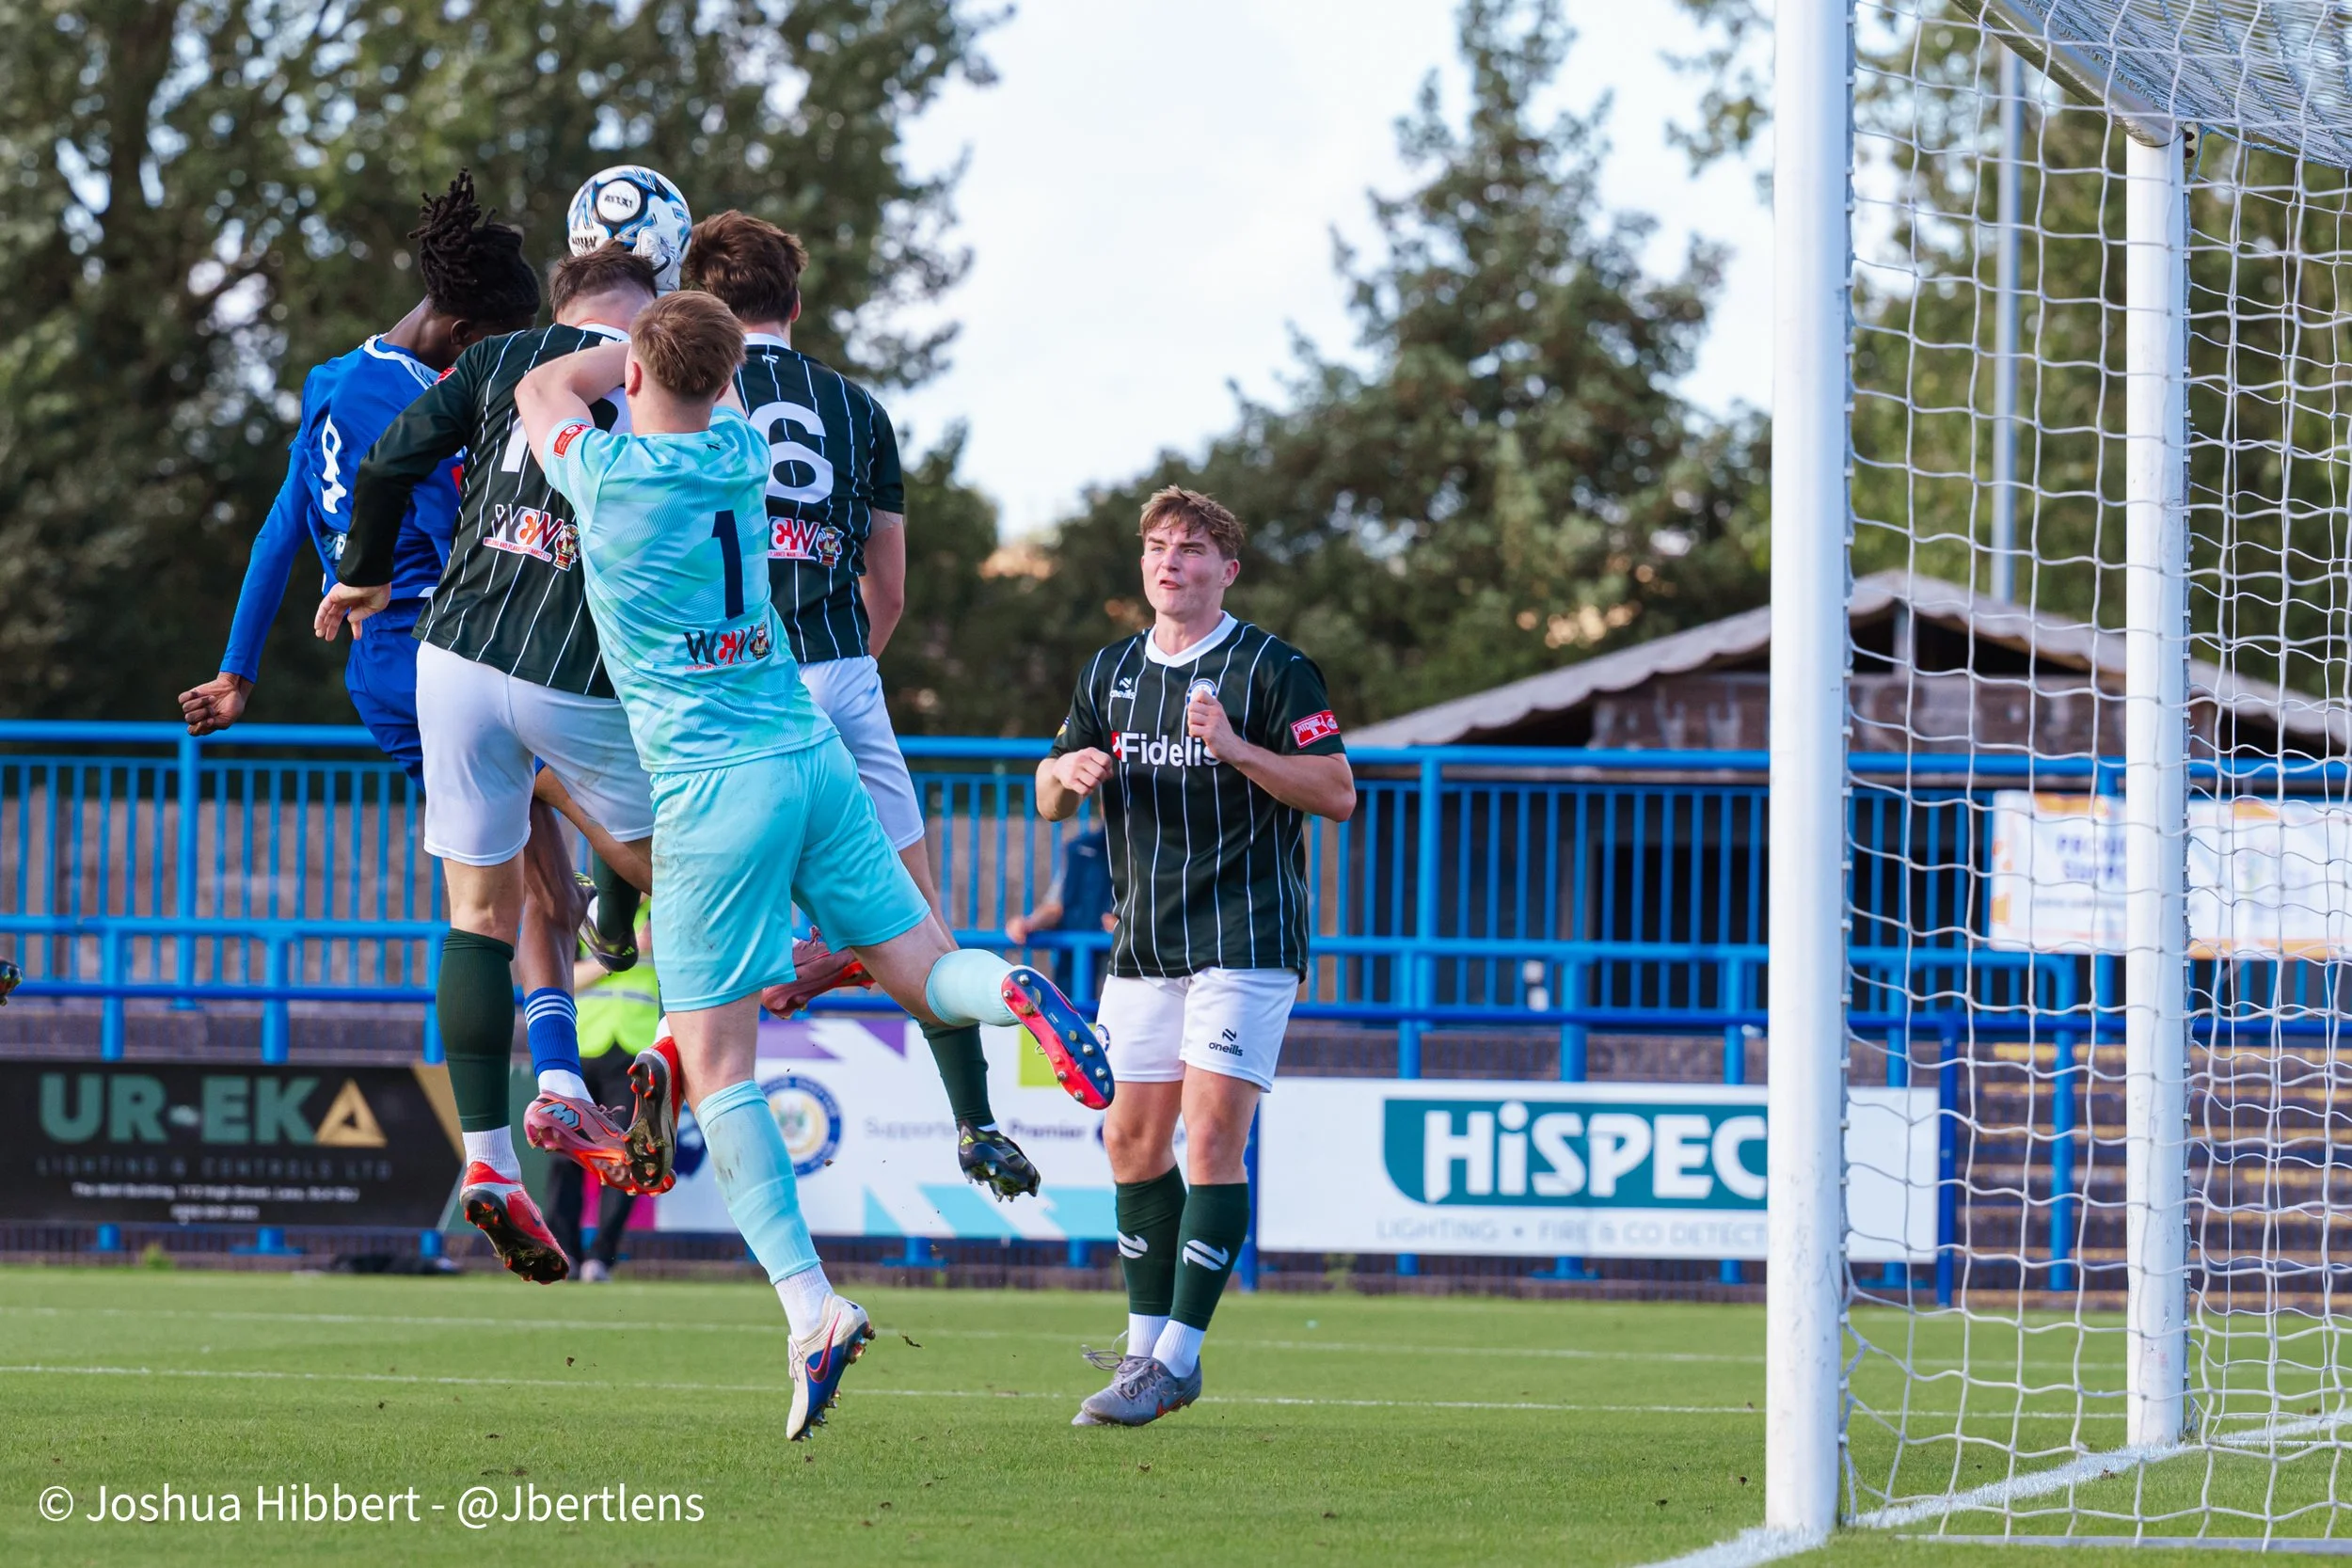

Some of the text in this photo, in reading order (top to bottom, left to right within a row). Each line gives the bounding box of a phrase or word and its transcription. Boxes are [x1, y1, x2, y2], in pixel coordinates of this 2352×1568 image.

[750, 401, 834, 504] 6
[711, 509, 745, 620] 1
[1209, 1042, 1243, 1056] oneills
